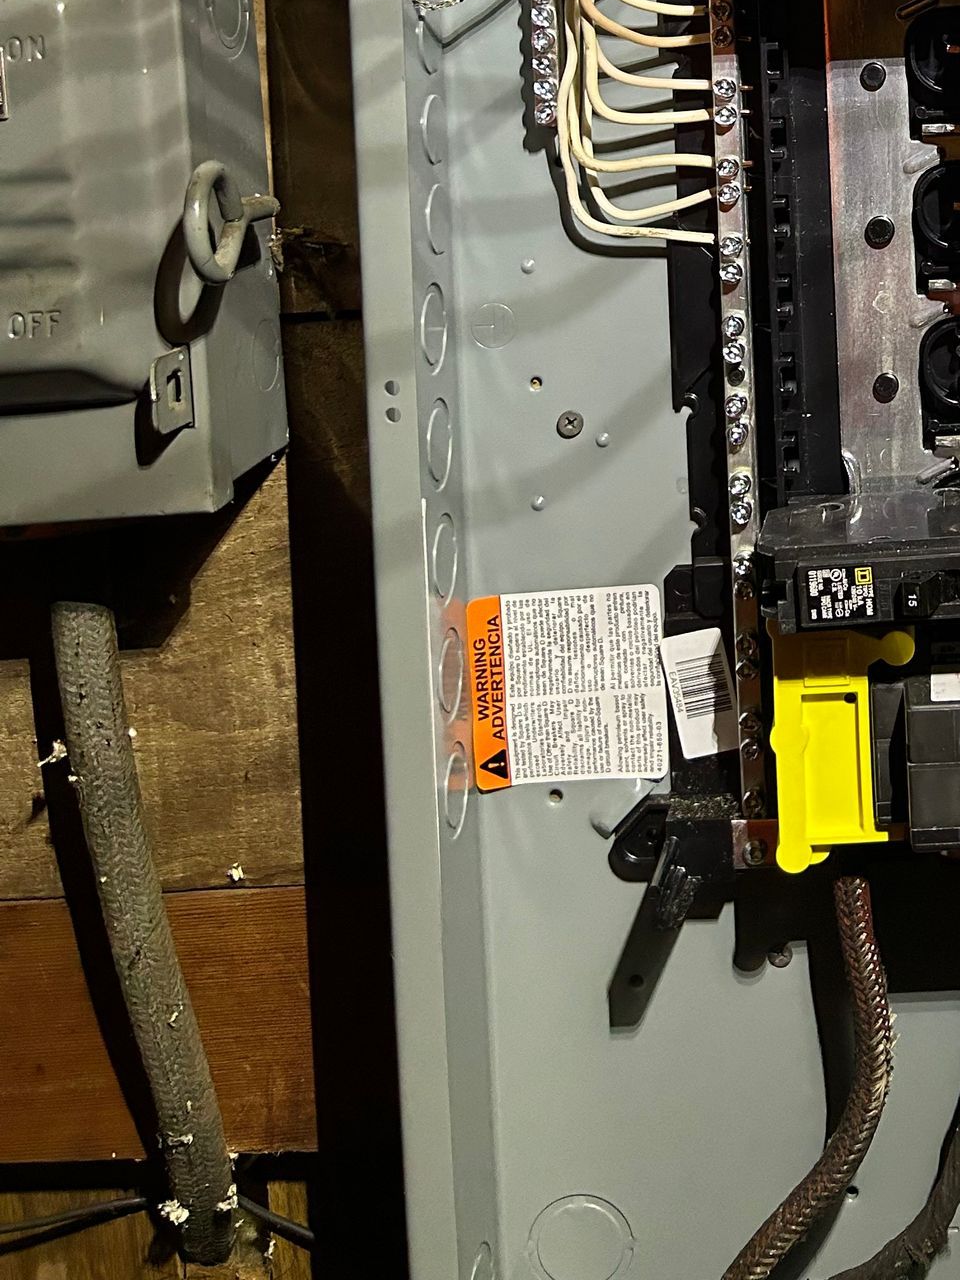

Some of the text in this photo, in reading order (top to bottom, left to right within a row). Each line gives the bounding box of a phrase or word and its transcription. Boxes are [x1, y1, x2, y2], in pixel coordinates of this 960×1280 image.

[6, 35, 46, 61] ON
[8, 310, 61, 340] OFF
[865, 598, 874, 616] HOM
[907, 593, 918, 607] 15
[472, 637, 489, 722] WARNING
[487, 615, 506, 741] ADVERTENCIA
[669, 671, 684, 714] EAV35484
